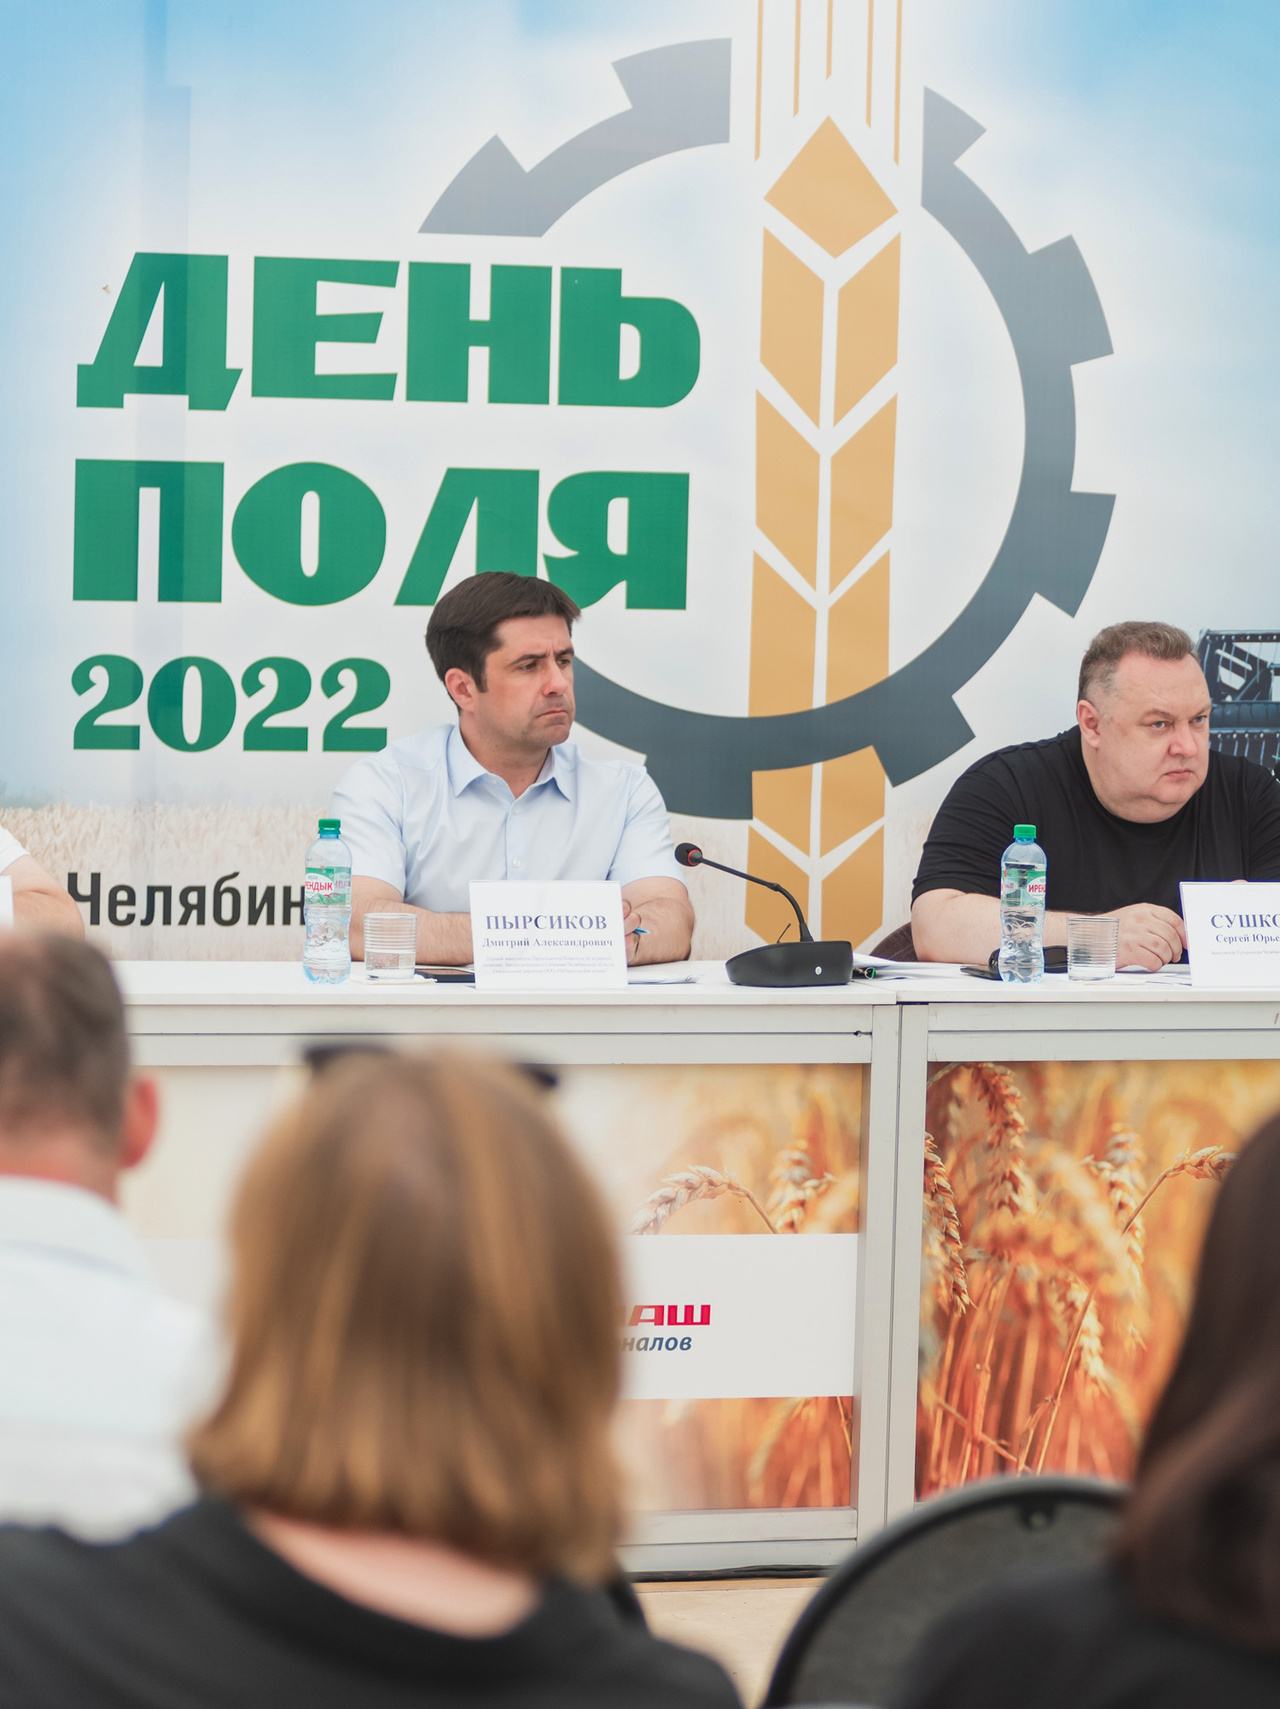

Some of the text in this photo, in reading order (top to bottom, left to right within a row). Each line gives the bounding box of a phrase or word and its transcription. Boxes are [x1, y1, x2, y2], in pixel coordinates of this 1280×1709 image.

[76, 252, 701, 411] ДЕНЬ
[72, 458, 690, 611] ПОЛЯ
[71, 654, 391, 753] 2022
[482, 937, 613, 949] Дмитрий Александрович
[486, 914, 608, 930] ПЫРСИКОВ
[1215, 933, 1250, 945] Сергей
